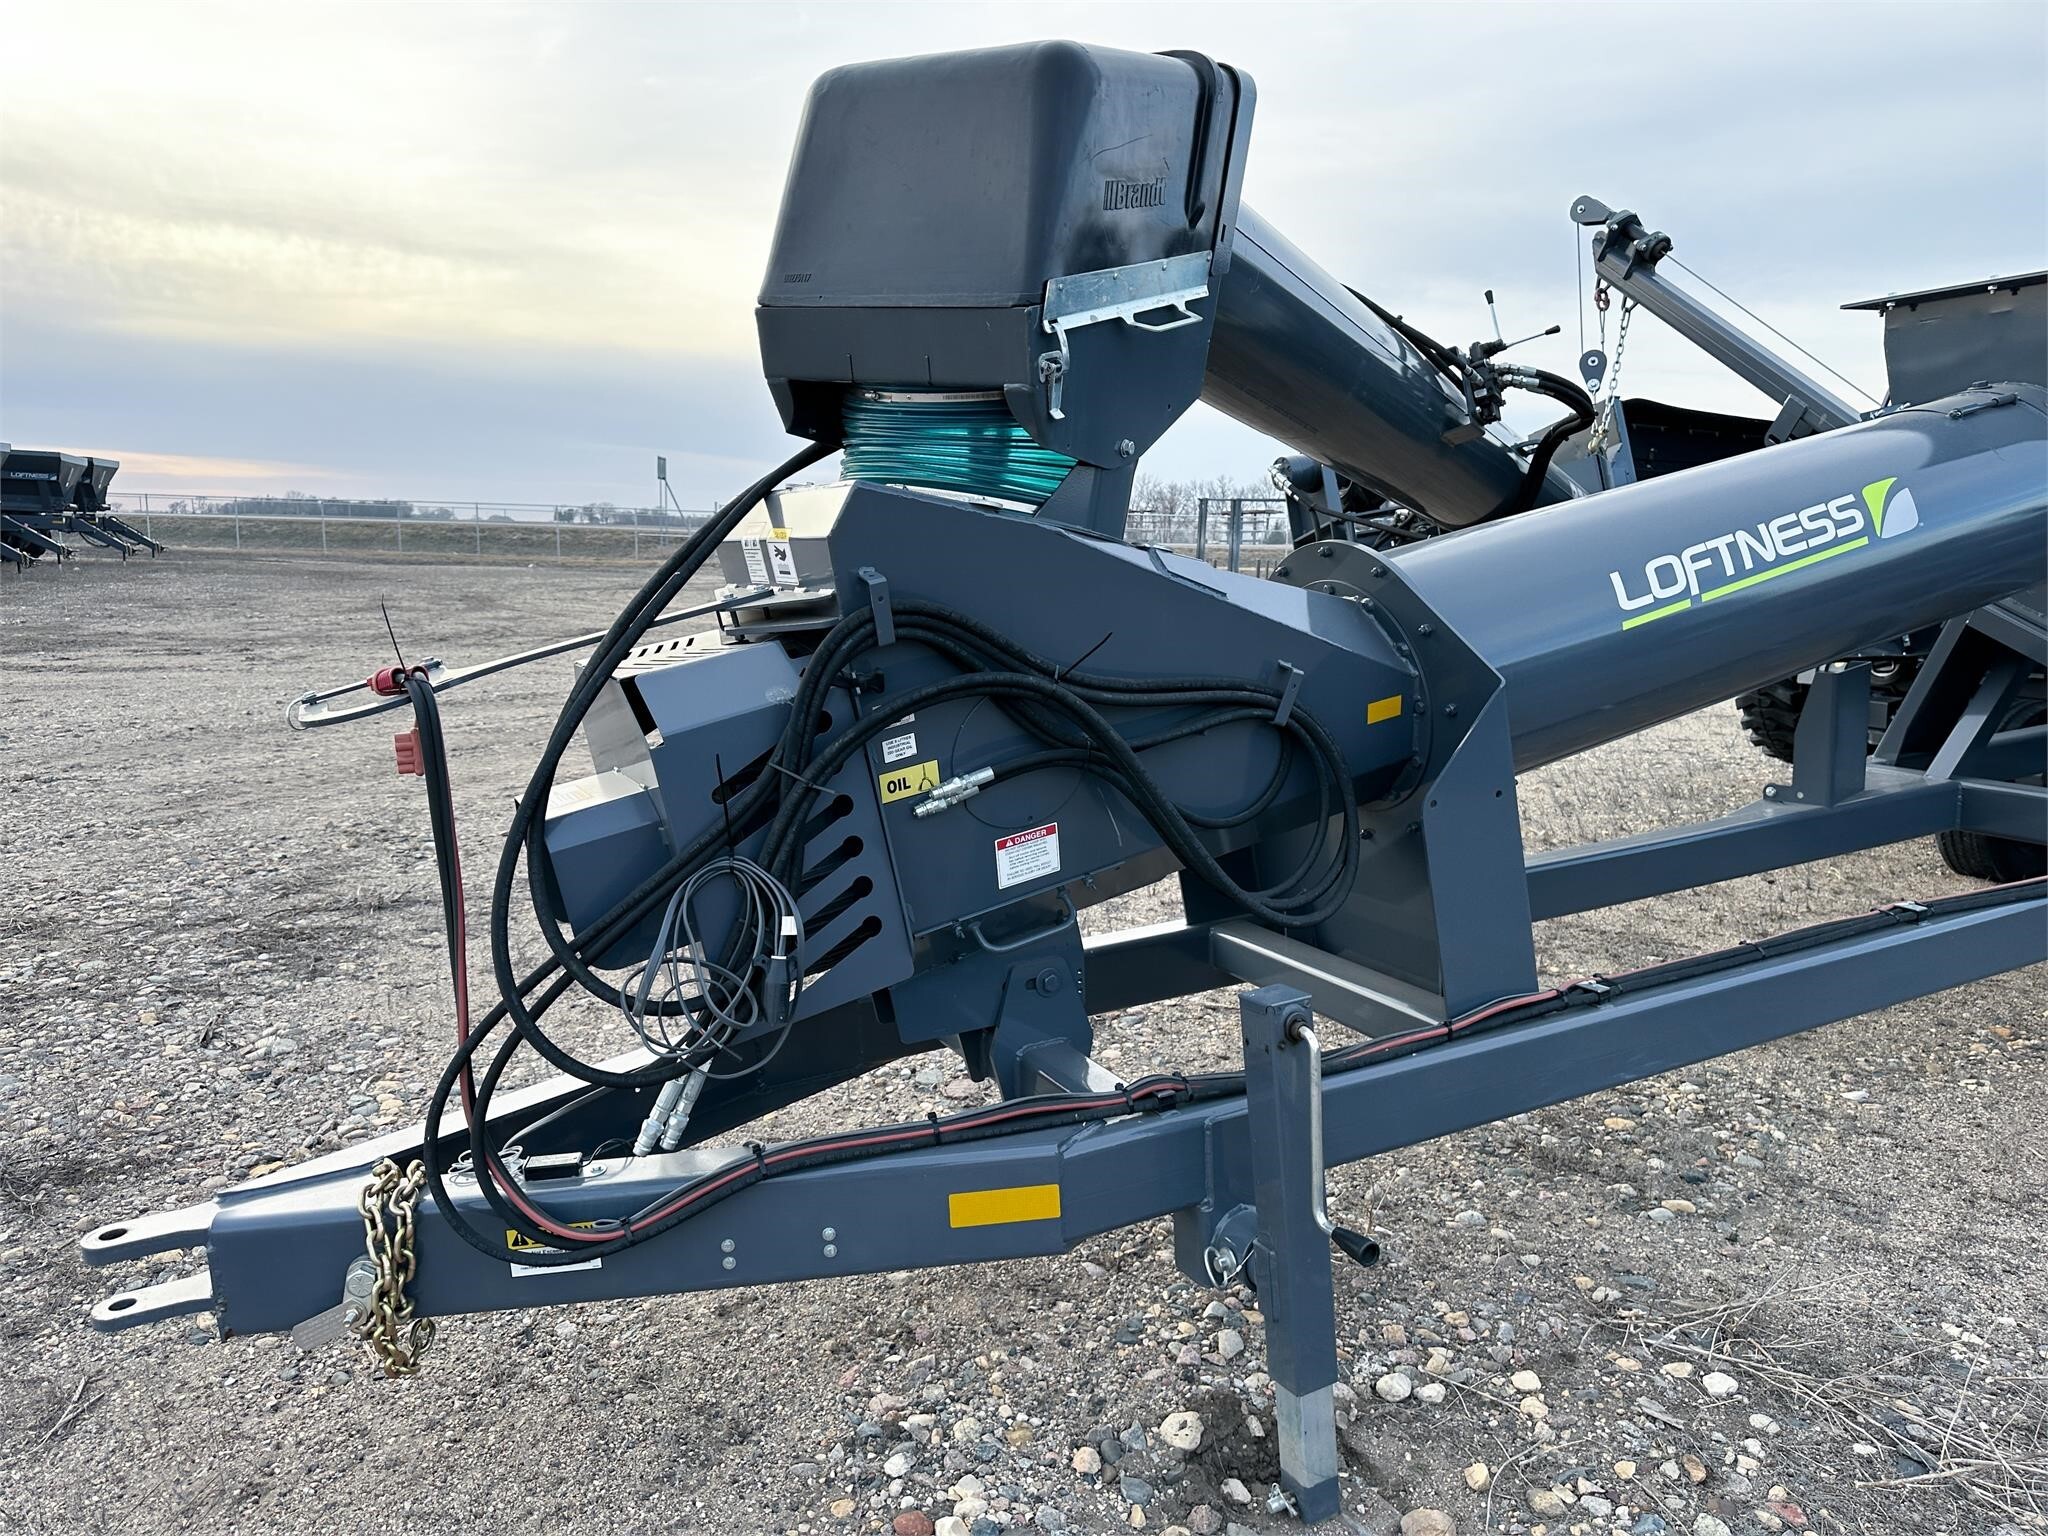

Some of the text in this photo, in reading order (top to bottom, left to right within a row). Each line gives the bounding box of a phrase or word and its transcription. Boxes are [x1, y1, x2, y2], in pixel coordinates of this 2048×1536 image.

[1114, 177, 1166, 210] Brandt
[10, 471, 49, 479] LOFTNESS
[1609, 493, 1865, 611] LOFTNESS
[887, 777, 911, 794] OIL
[1014, 829, 1047, 844] DANGER
